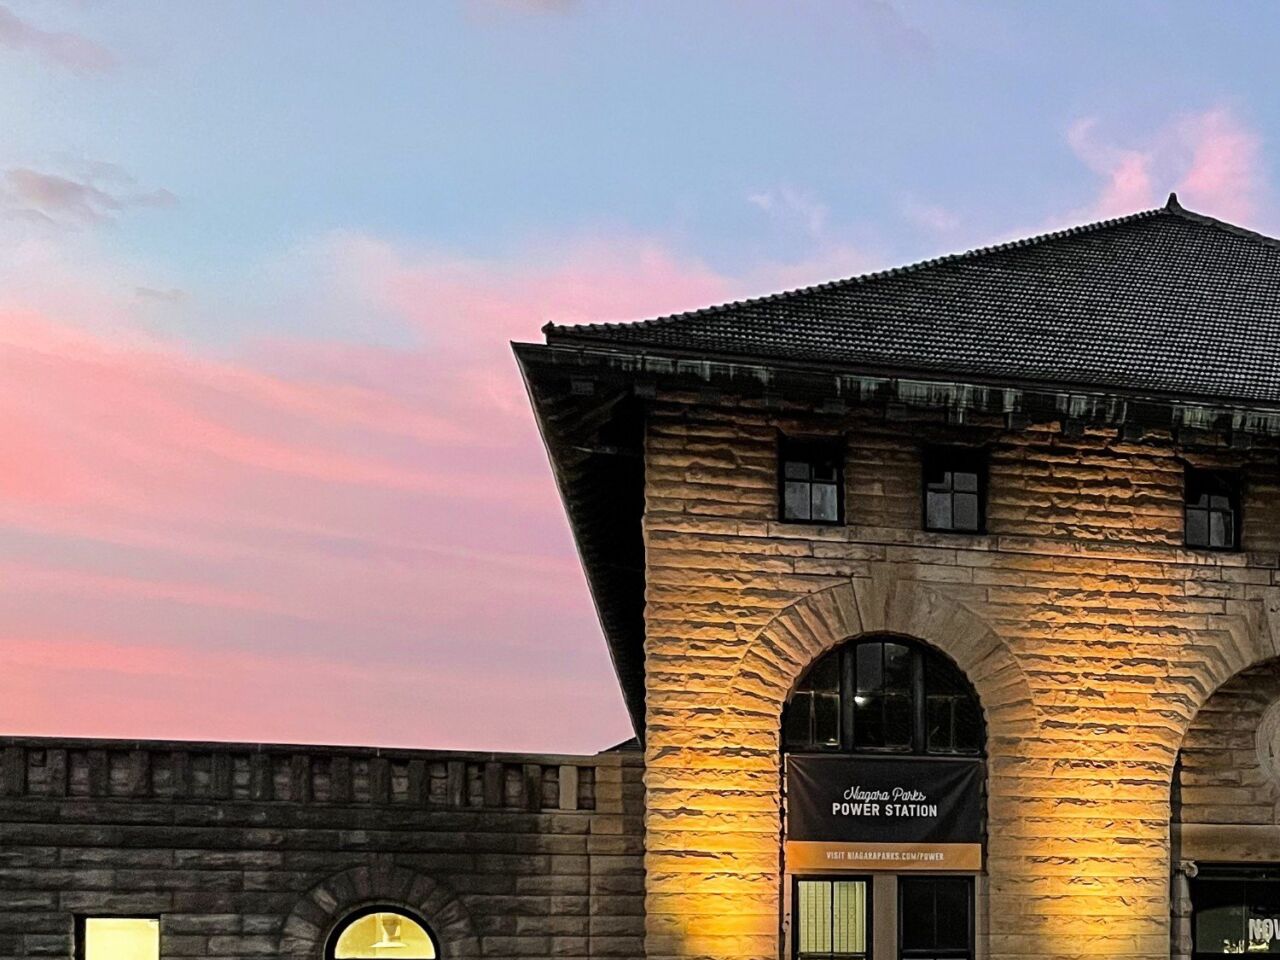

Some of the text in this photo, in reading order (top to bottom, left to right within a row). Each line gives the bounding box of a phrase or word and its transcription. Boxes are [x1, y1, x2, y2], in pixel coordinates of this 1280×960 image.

[843, 786, 927, 803] Niagara Parks
[832, 802, 938, 817] POWER STATION
[826, 851, 945, 861] VISIT NIAGARAPARKS.COM/POWER
